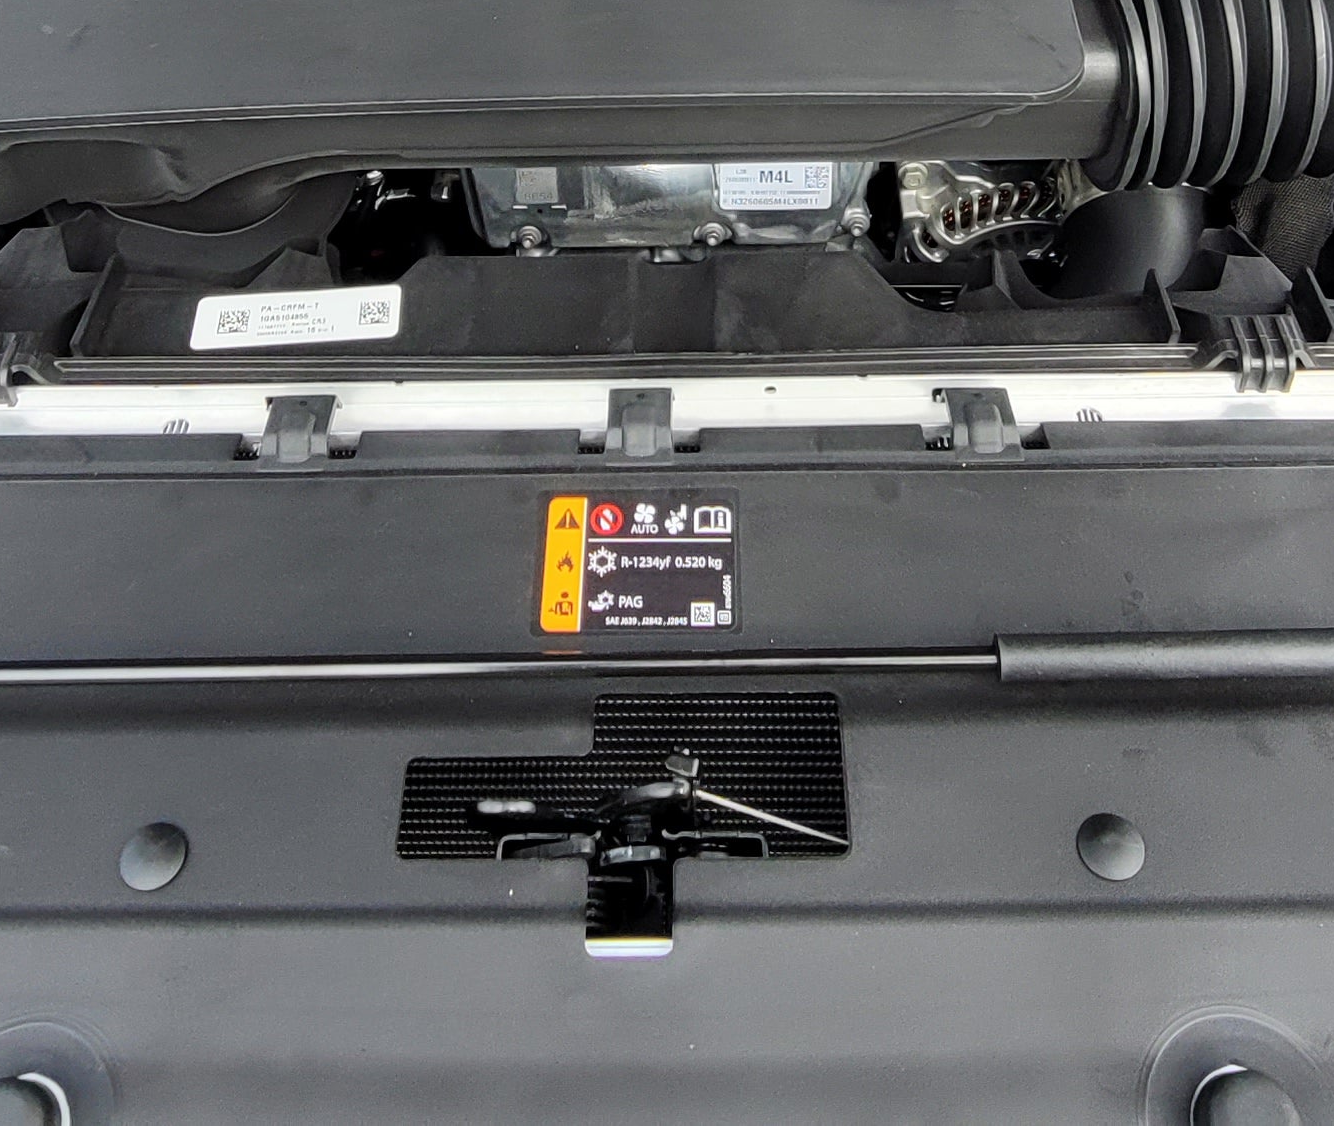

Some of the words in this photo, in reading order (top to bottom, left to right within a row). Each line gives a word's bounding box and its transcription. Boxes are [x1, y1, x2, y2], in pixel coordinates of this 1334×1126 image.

[759, 170, 793, 184] M4L
[630, 524, 659, 534] AUTO
[620, 556, 672, 571] R-1234yf
[675, 556, 706, 569] 0.520
[708, 555, 723, 571] kg
[618, 595, 643, 609] PAG
